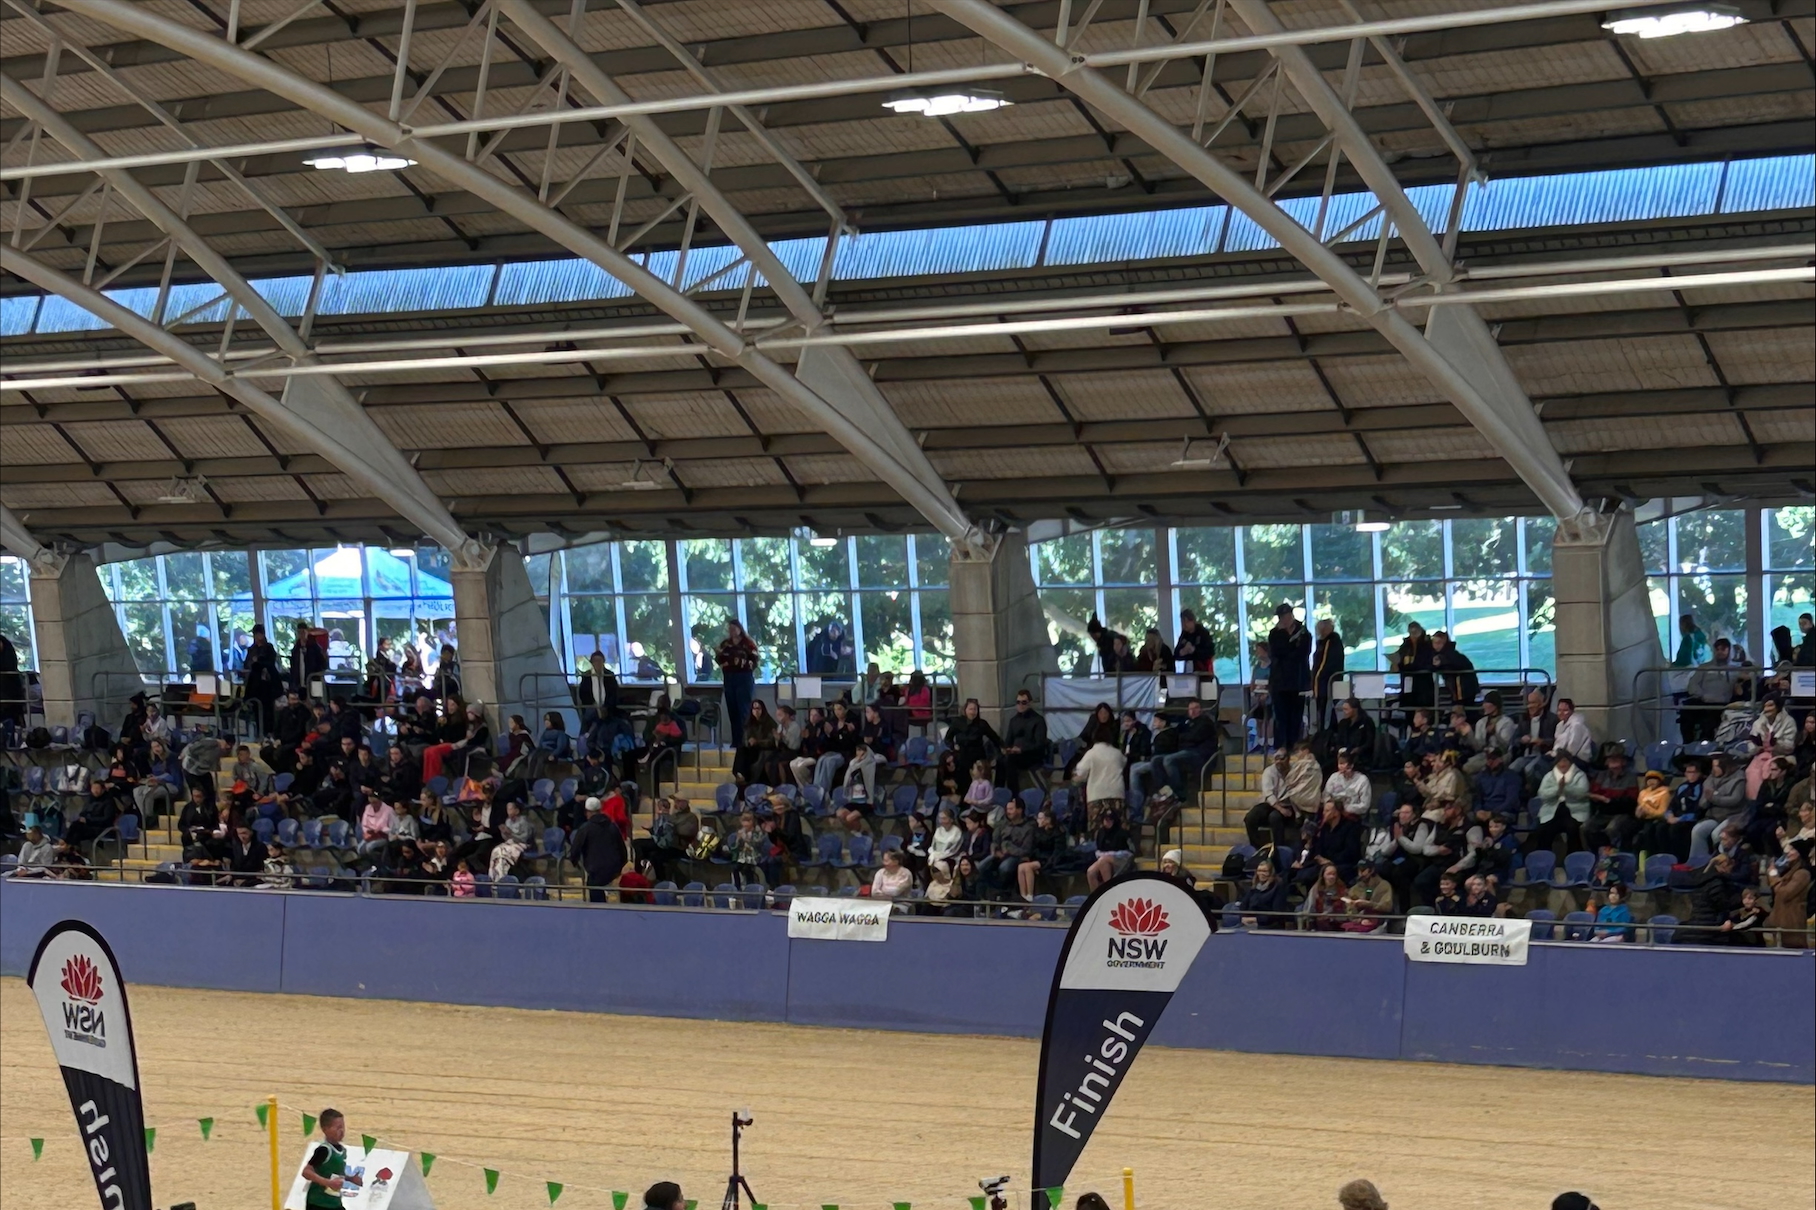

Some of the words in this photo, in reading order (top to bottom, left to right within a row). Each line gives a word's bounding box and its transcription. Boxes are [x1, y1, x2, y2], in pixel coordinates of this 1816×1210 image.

[797, 911, 836, 924] WAGGA
[839, 912, 880, 926] WAGGA
[1429, 922, 1505, 936] CANBERRA
[1107, 937, 1168, 960] NSW
[1420, 941, 1431, 955] &
[1434, 941, 1510, 957] GOULBURN
[1049, 1010, 1145, 1140] Finish
